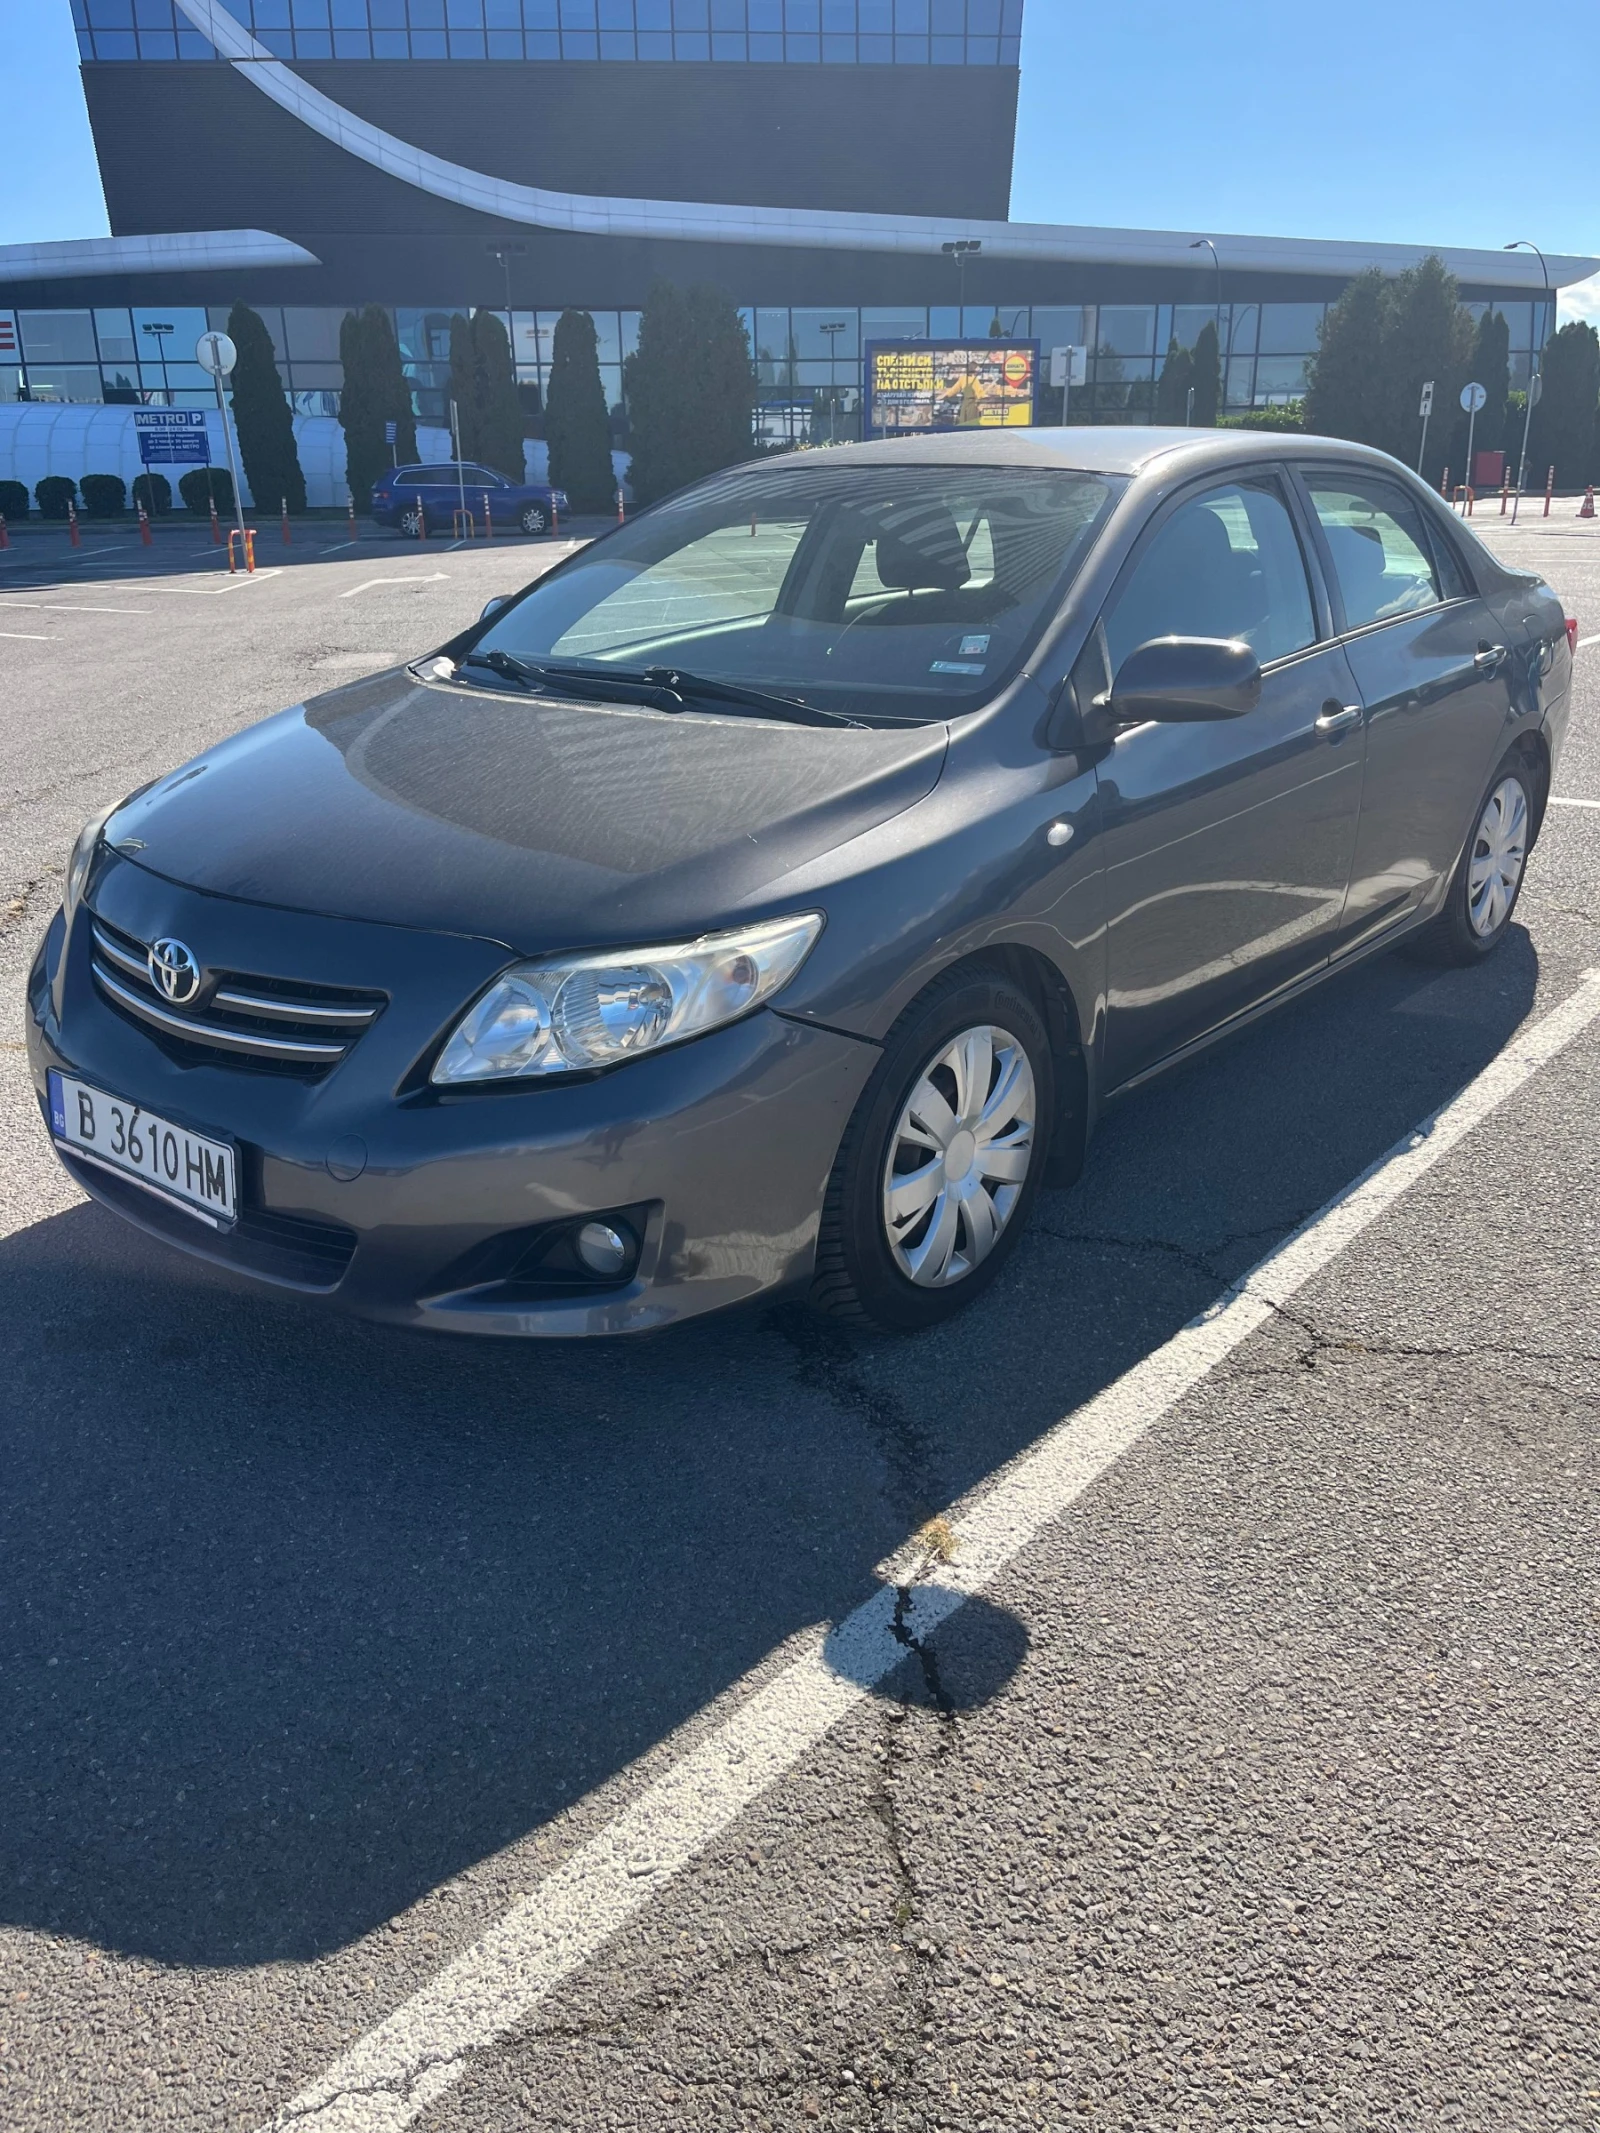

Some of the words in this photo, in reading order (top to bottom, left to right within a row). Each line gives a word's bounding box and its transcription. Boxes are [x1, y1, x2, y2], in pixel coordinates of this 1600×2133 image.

[917, 356, 932, 366] СИ
[876, 379, 892, 390] НА
[135, 413, 186, 424] METRO
[191, 413, 202, 424] P
[54, 1110, 64, 1127] BG
[78, 1090, 95, 1140] B
[110, 1107, 178, 1180] 3610
[185, 1139, 226, 1206] HM
